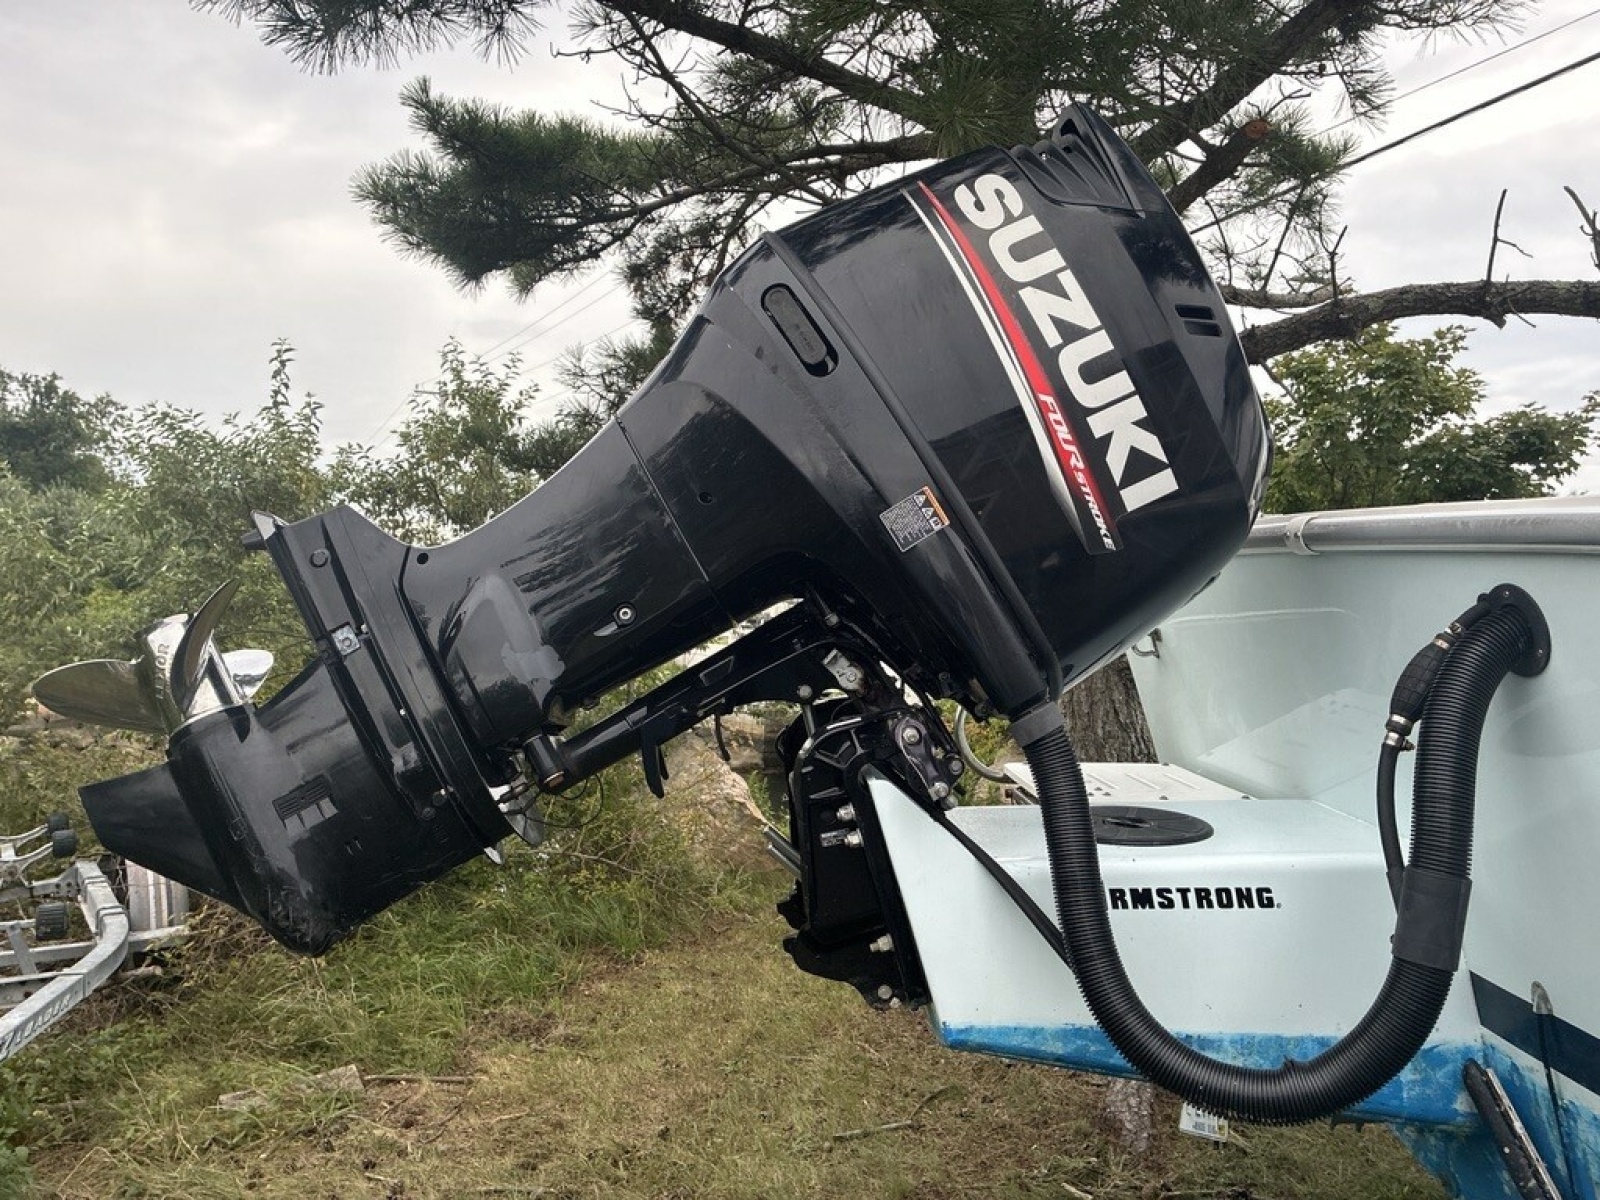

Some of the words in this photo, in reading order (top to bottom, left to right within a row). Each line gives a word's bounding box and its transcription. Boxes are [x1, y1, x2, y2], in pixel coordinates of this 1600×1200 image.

[954, 173, 1179, 512] SUZUKI
[1038, 393, 1085, 471] FOUR
[1073, 469, 1117, 550] STROKE
[1107, 887, 1276, 910] RMSTRONG
